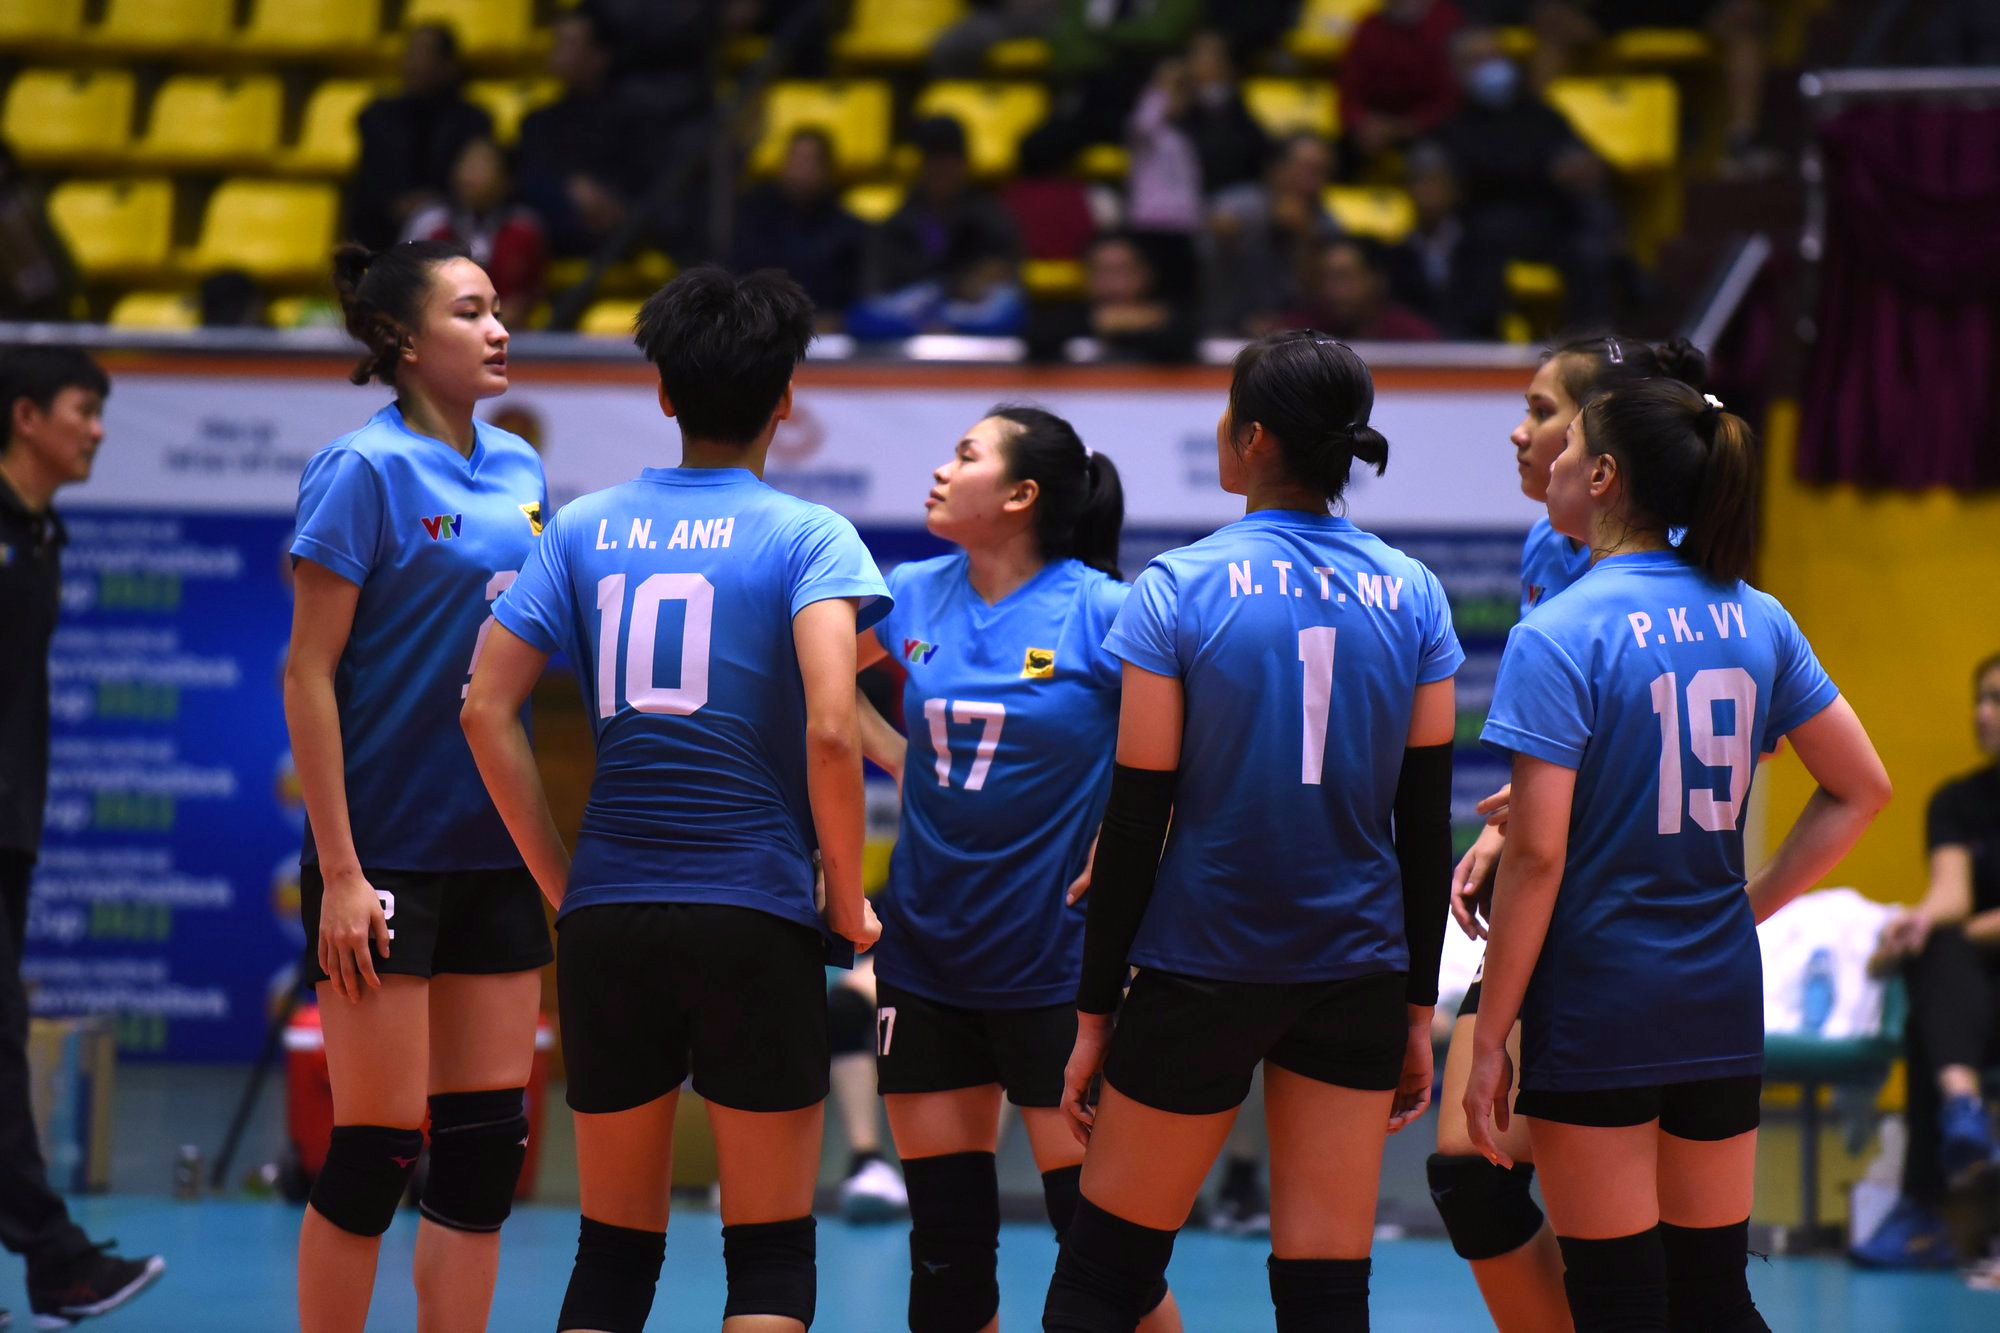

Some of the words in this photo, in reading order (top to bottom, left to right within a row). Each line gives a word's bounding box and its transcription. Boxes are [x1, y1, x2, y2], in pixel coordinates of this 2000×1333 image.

[420, 513, 462, 542] VTV
[595, 518, 617, 551] L.
[627, 517, 657, 550] N.
[667, 517, 735, 550] ANH
[1228, 559, 1263, 598] N.
[1272, 559, 1303, 598] T.
[1313, 566, 1346, 603] T.
[1357, 571, 1404, 611] MY
[596, 572, 715, 720] 10
[1707, 601, 1748, 639] VY
[903, 638, 940, 666] VTV
[1298, 625, 1337, 785] 1
[924, 698, 1006, 791] 17
[1649, 667, 1757, 835] 19
